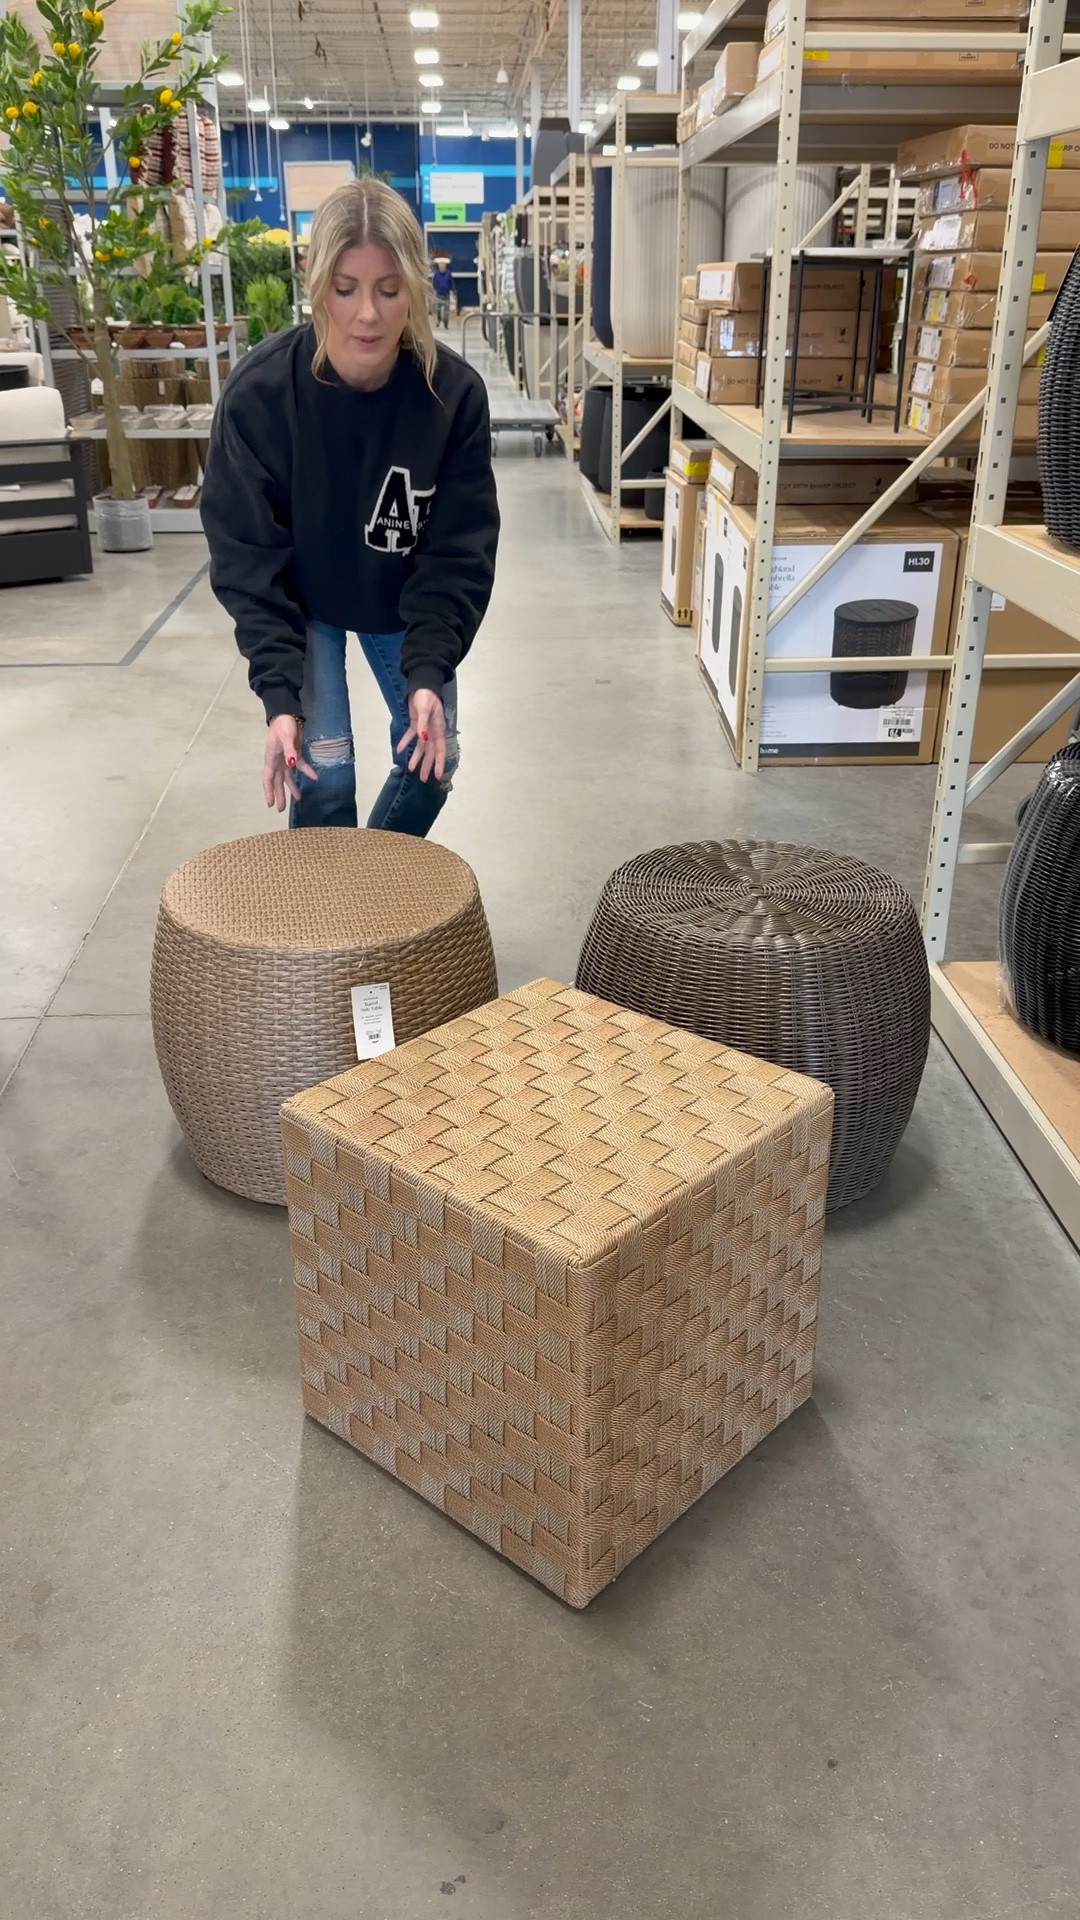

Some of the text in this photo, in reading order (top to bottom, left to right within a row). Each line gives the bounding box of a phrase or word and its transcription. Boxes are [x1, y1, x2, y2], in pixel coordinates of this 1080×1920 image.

[377, 516, 411, 530] ANINE
[908, 557, 931, 566] HL30
[770, 565, 795, 574] ghland
